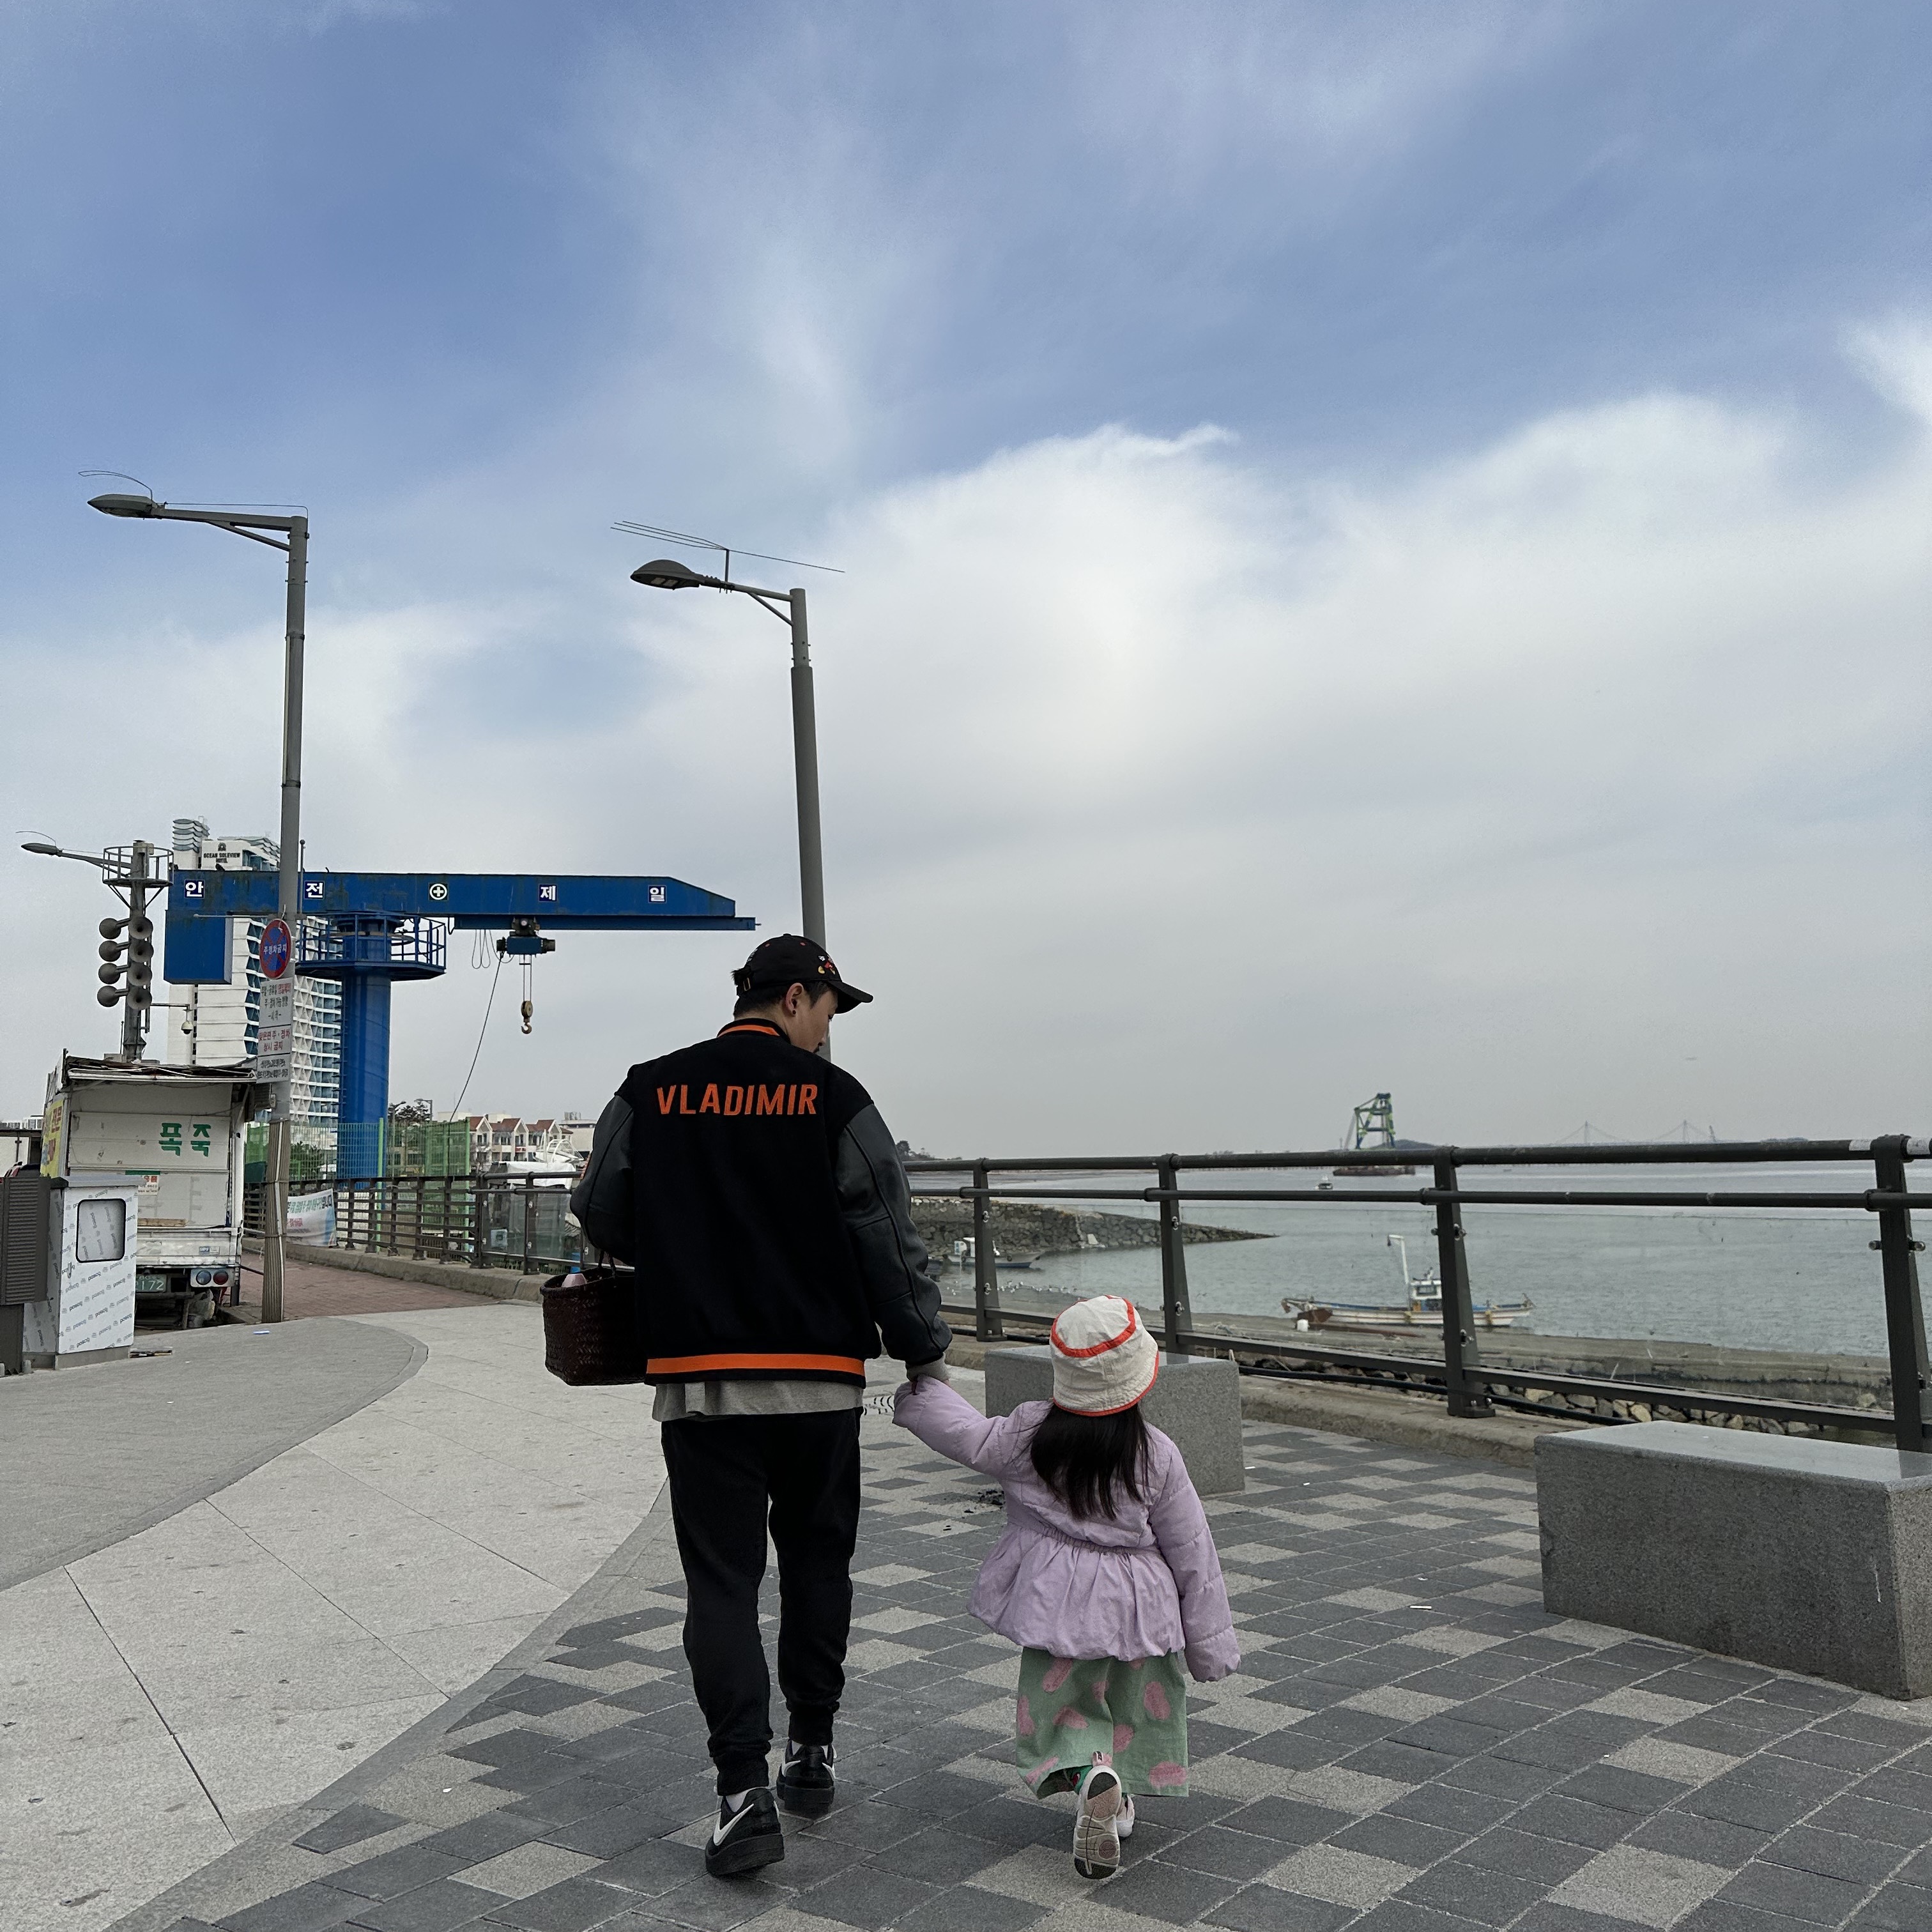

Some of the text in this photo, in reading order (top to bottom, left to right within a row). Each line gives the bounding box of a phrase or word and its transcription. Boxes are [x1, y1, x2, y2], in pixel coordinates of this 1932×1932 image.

[185, 882, 664, 901] 안 전 제 일
[273, 1041, 282, 1051] 금지
[657, 1084, 818, 1116] VLADIMIR
[158, 1123, 211, 1157] 폭죽
